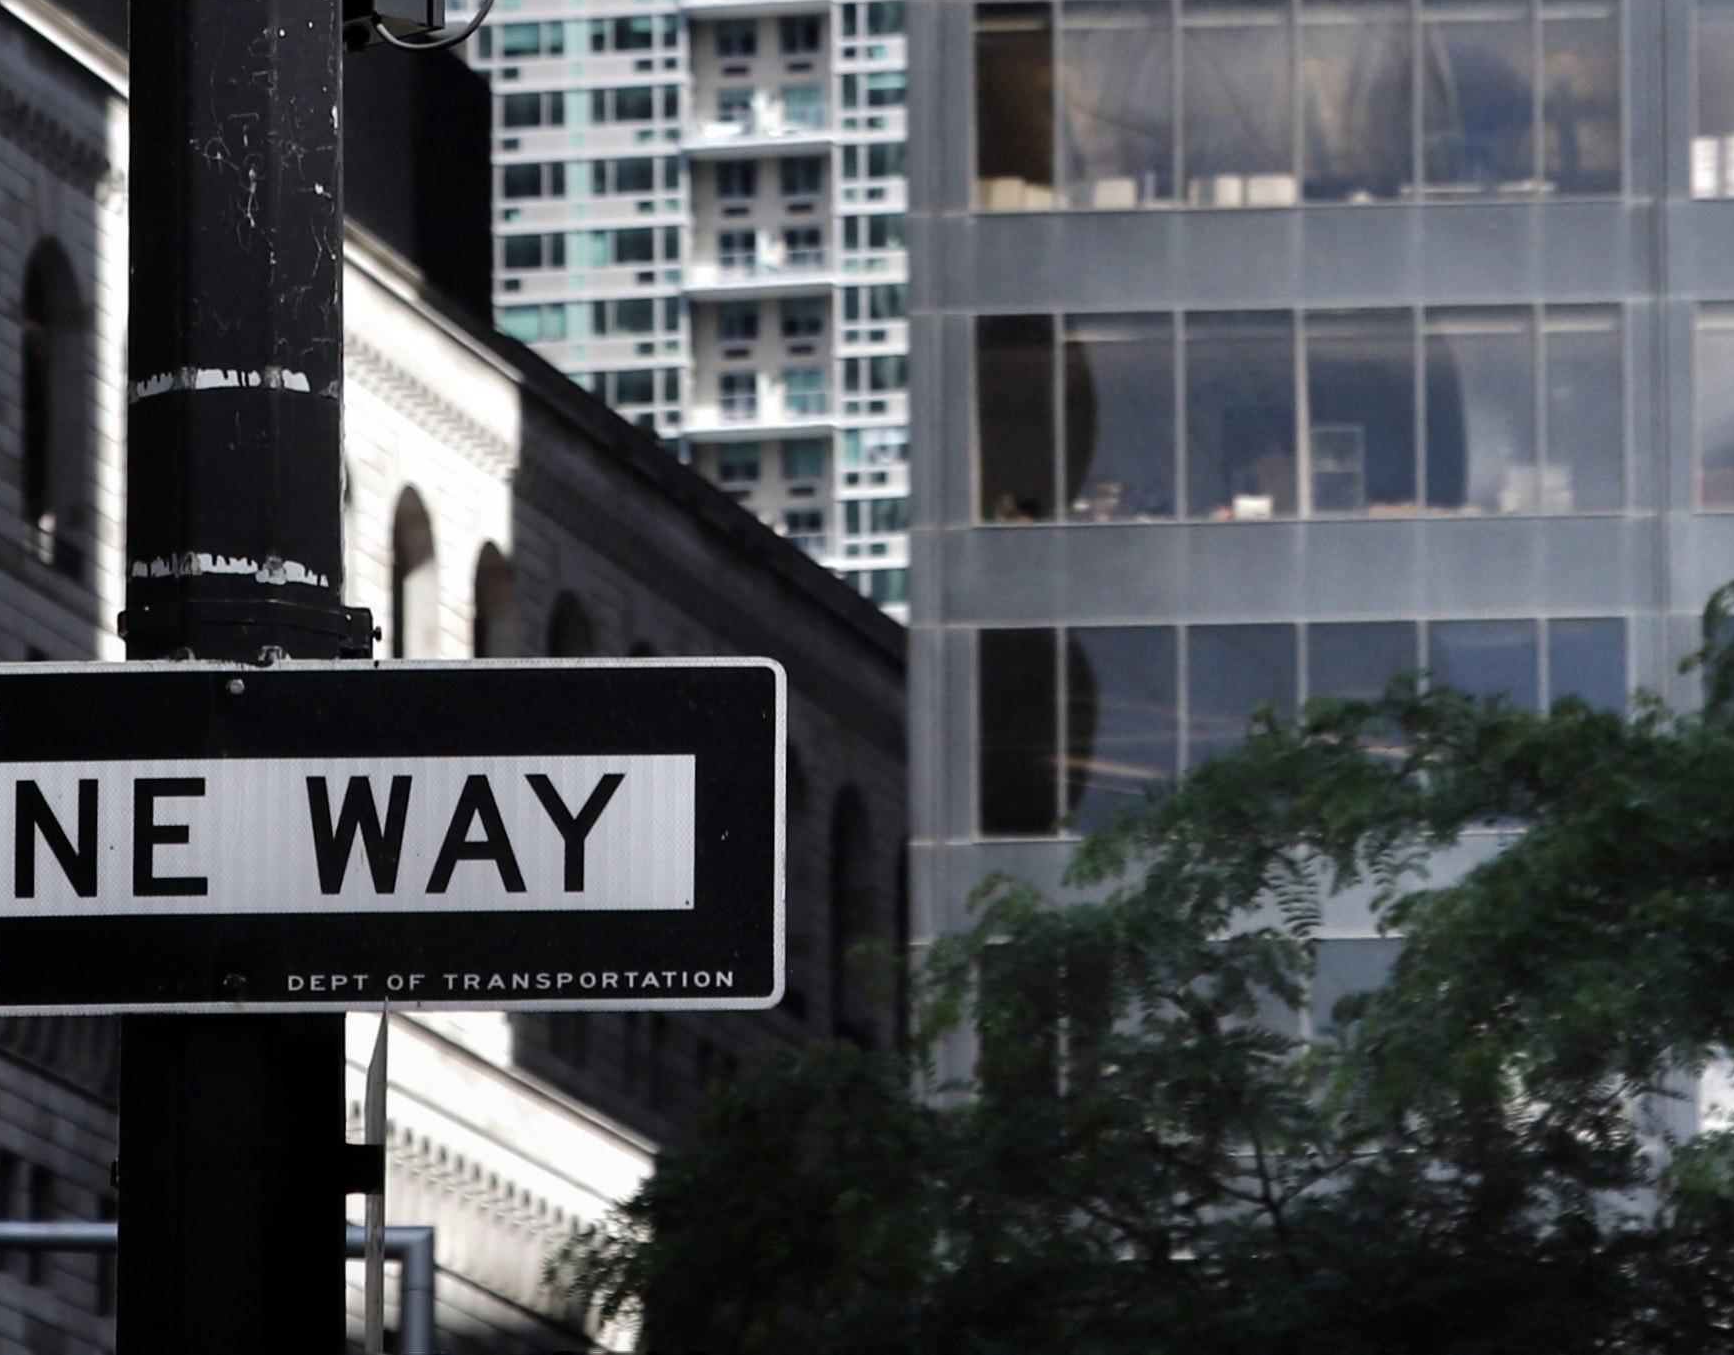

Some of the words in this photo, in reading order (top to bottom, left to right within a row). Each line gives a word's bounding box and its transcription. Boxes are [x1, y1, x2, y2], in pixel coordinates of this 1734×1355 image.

[304, 772, 627, 897] WAY
[286, 974, 370, 992] DEPT
[385, 974, 427, 992] OF
[442, 969, 735, 991] TRANSPORTATION
